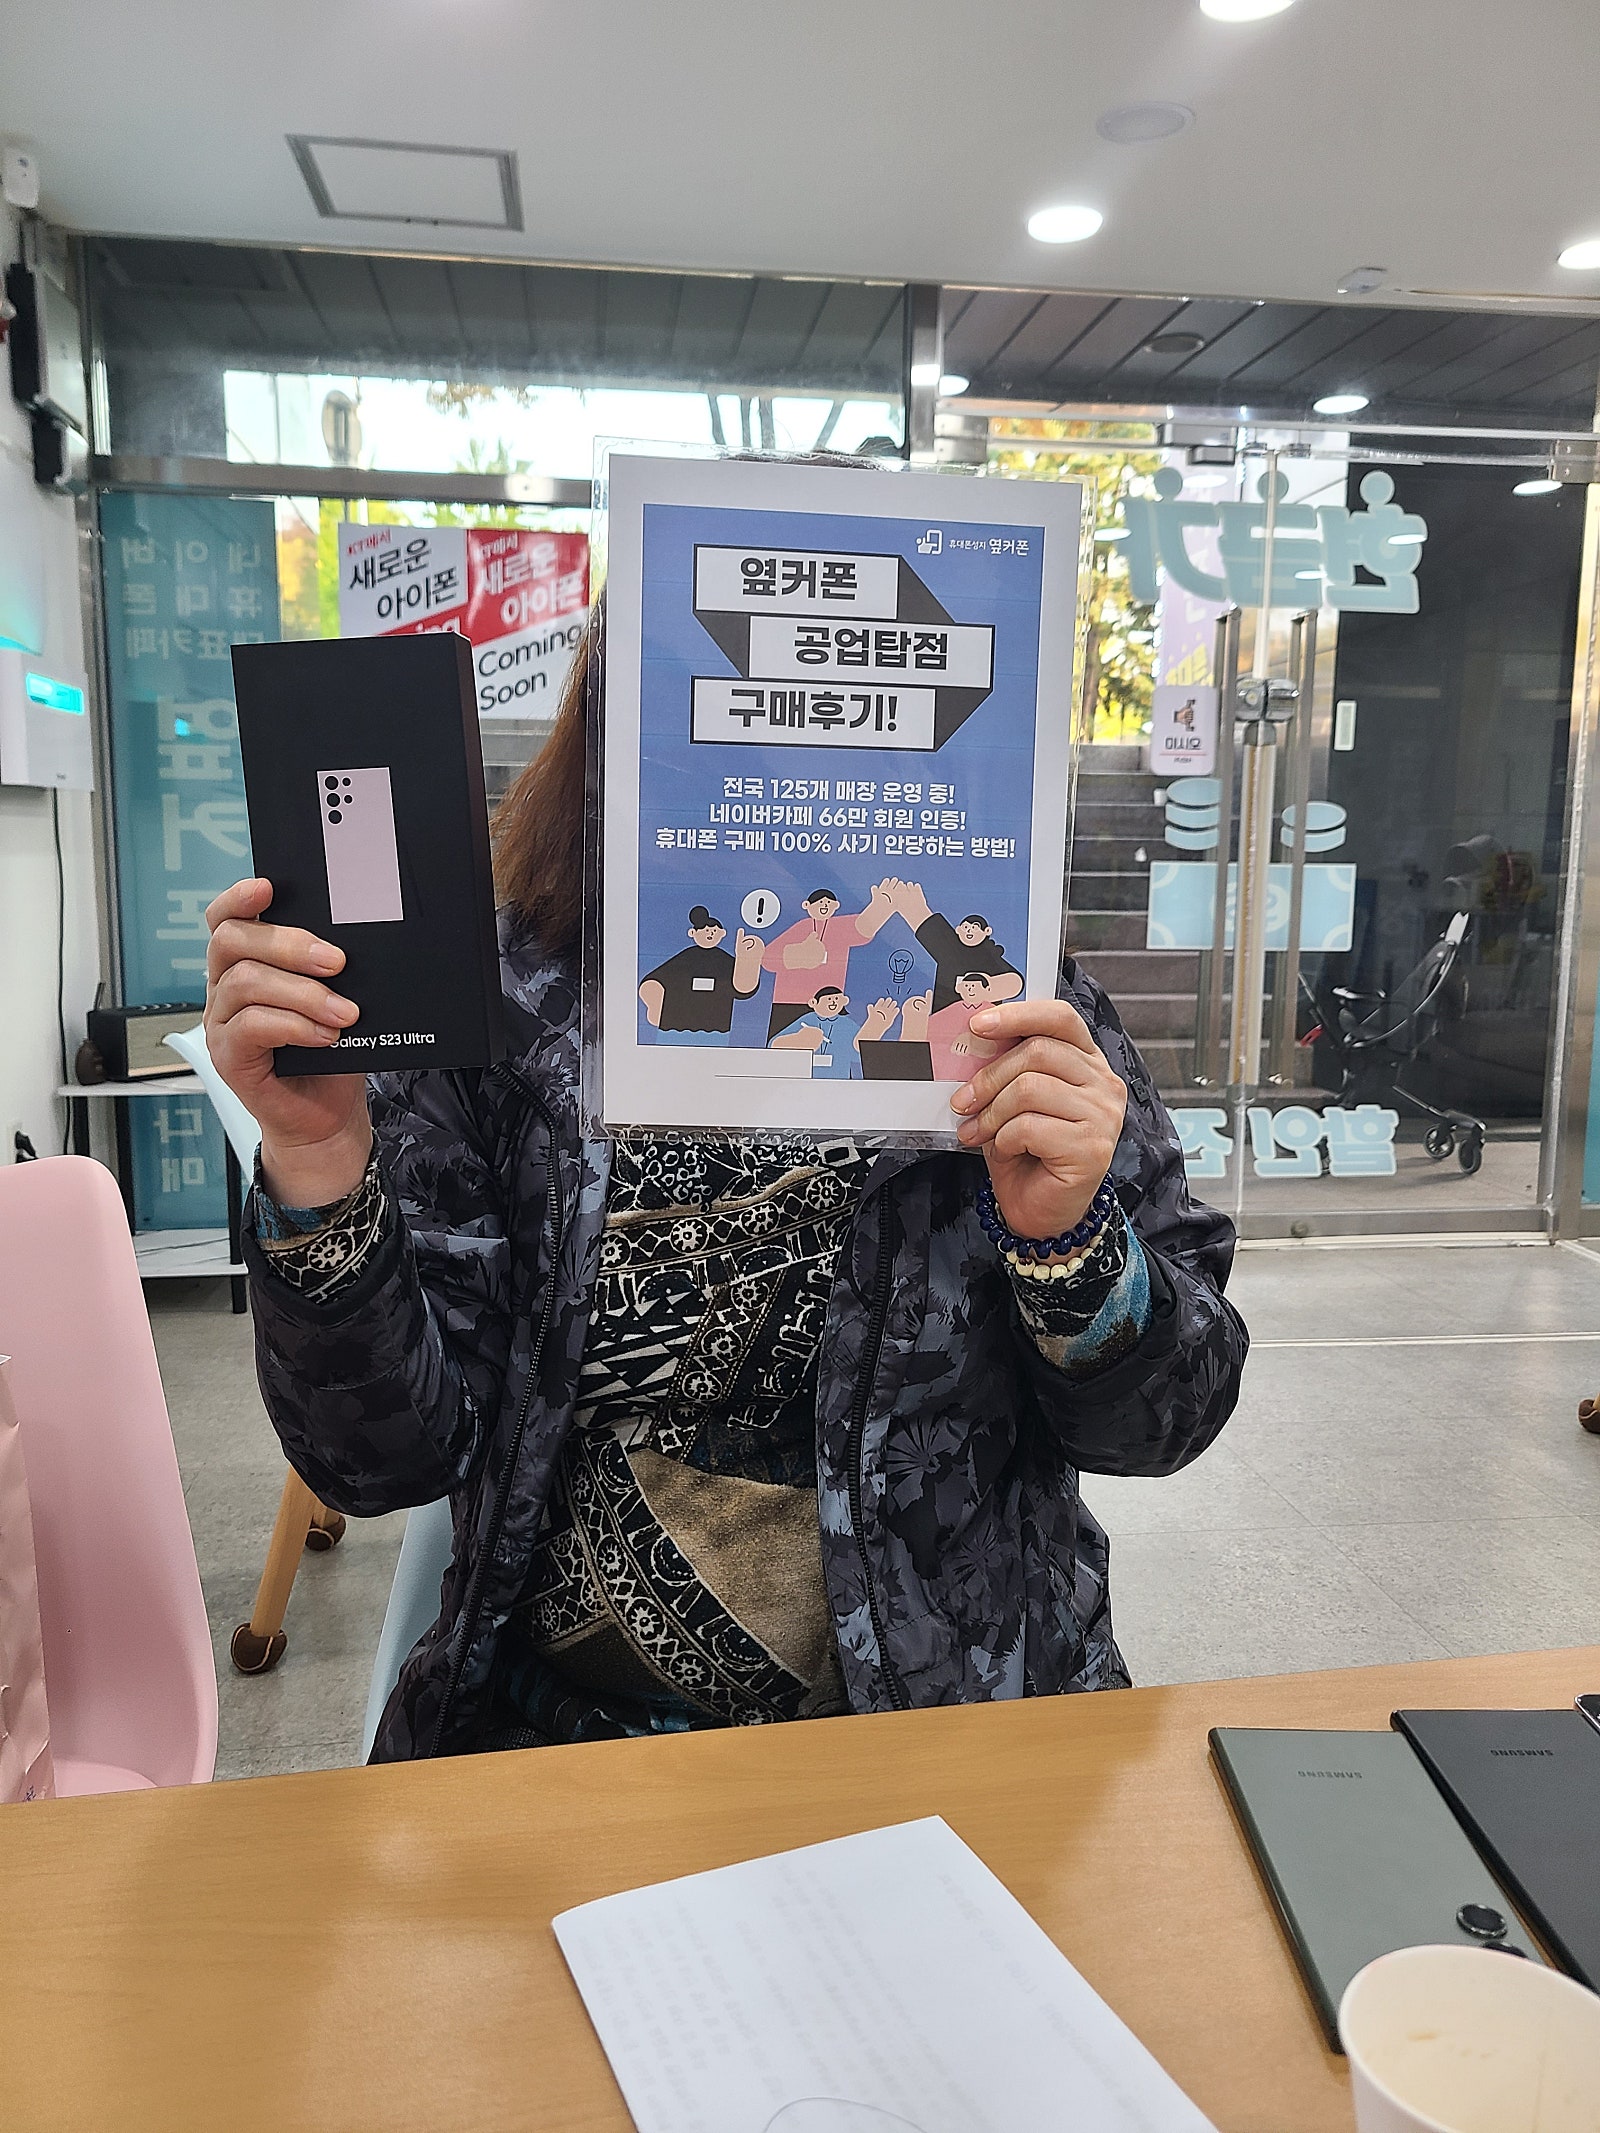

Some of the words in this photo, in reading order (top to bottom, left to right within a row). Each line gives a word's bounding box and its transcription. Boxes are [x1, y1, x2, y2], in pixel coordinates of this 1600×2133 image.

[350, 538, 432, 590] 새로운
[480, 540, 557, 595] 새로운
[948, 539, 987, 551] 휴대폰성지
[989, 538, 1030, 556] 옆커폰
[377, 566, 459, 619] 아이폰
[500, 571, 586, 625] 아이폰
[740, 557, 858, 600] 옆커폰
[478, 624, 582, 677] Coming
[794, 625, 949, 670] 공업탑점
[480, 671, 547, 711] Soon
[729, 688, 898, 732] 구매후기!
[723, 776, 765, 799] 전국
[770, 779, 829, 801] 125개
[835, 780, 877, 802] 매장
[883, 782, 922, 804] 운영
[929, 783, 955, 804] 중!
[709, 803, 813, 826] 네이버카페
[818, 807, 868, 828] 66만
[873, 808, 914, 829] 회원
[920, 809, 966, 831] 인증!
[655, 827, 718, 850] 휴대폰
[723, 829, 765, 851] 구매
[771, 831, 832, 853] 100%
[837, 833, 878, 855] 사기
[884, 834, 965, 857] 안당하는
[970, 836, 1016, 858] 방법!
[379, 1033, 402, 1046] S23
[403, 1032, 435, 1045] Ultra
[1490, 1749, 1553, 1757] SAMSUNG
[1298, 1769, 1363, 1779] SAMSUNG
